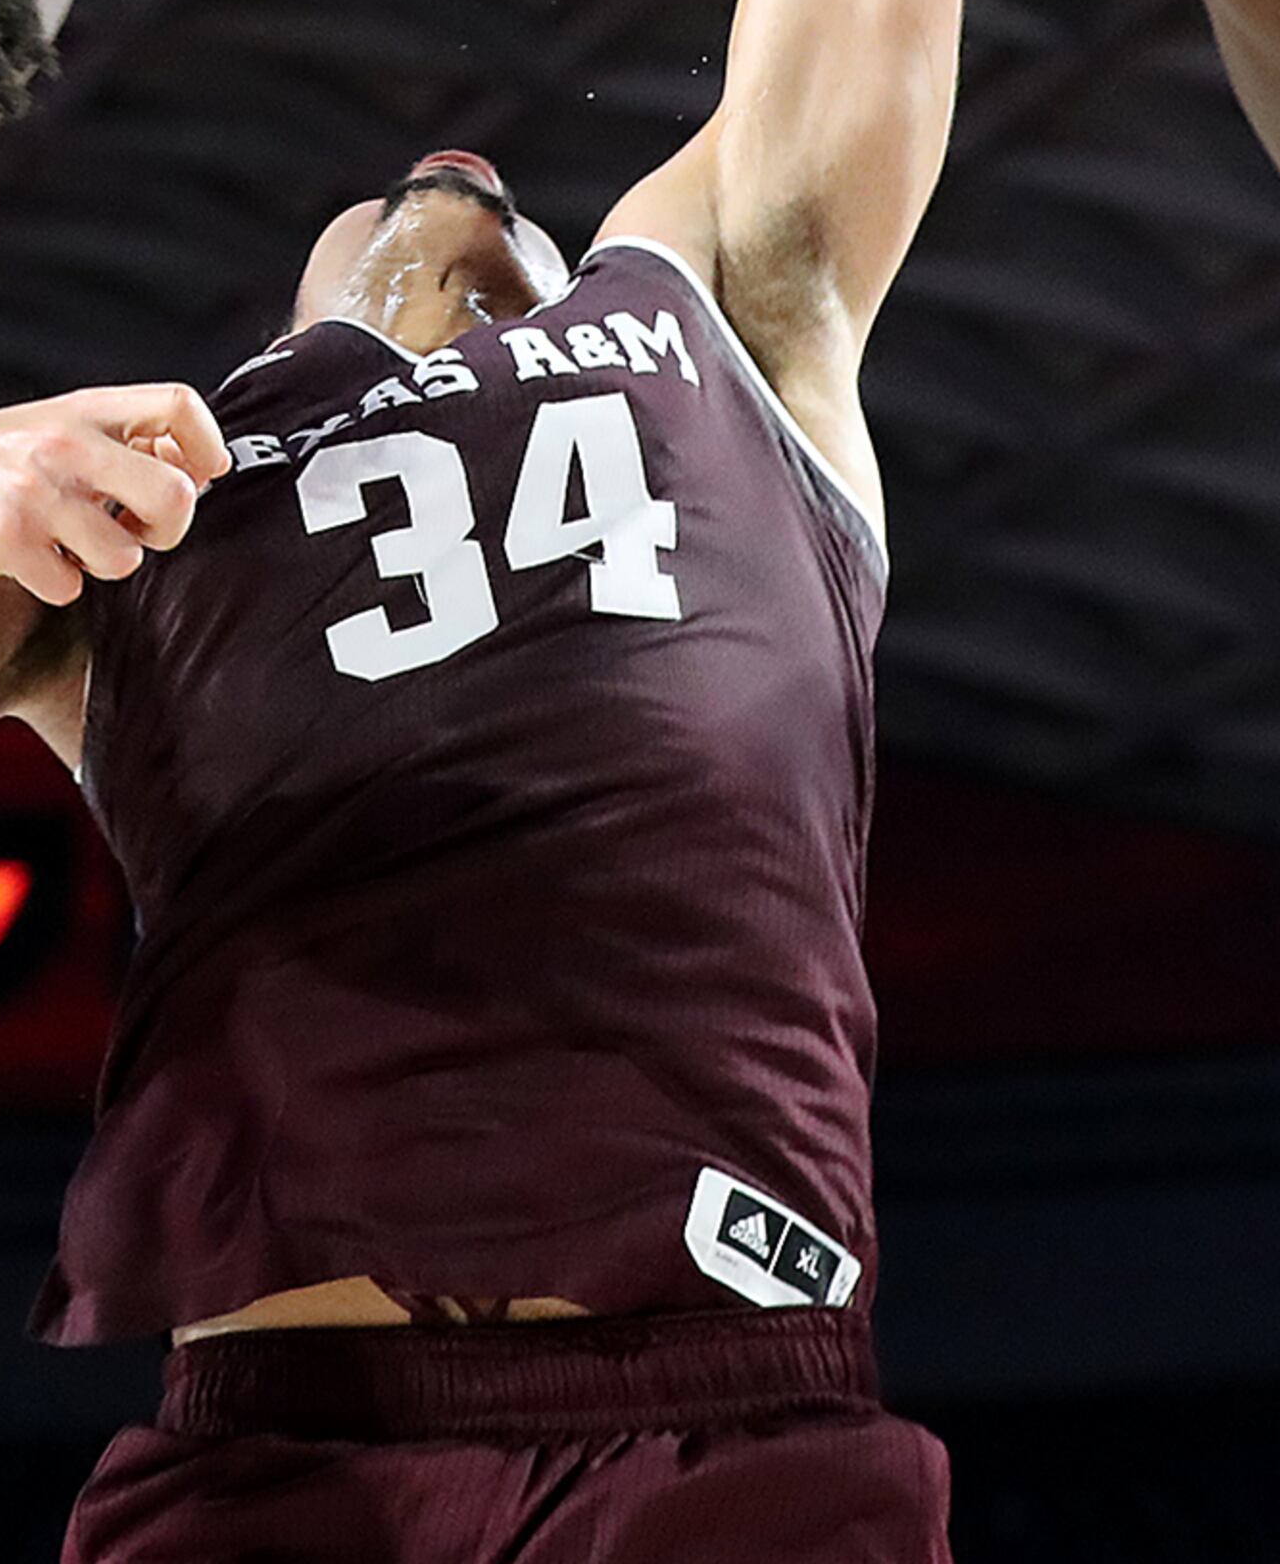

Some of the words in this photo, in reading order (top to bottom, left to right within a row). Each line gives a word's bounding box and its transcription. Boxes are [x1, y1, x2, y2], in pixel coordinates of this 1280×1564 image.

[200, 347, 480, 494] EXAS
[498, 310, 700, 387] A&M
[296, 392, 683, 683] 34
[795, 1247, 819, 1280] XL
